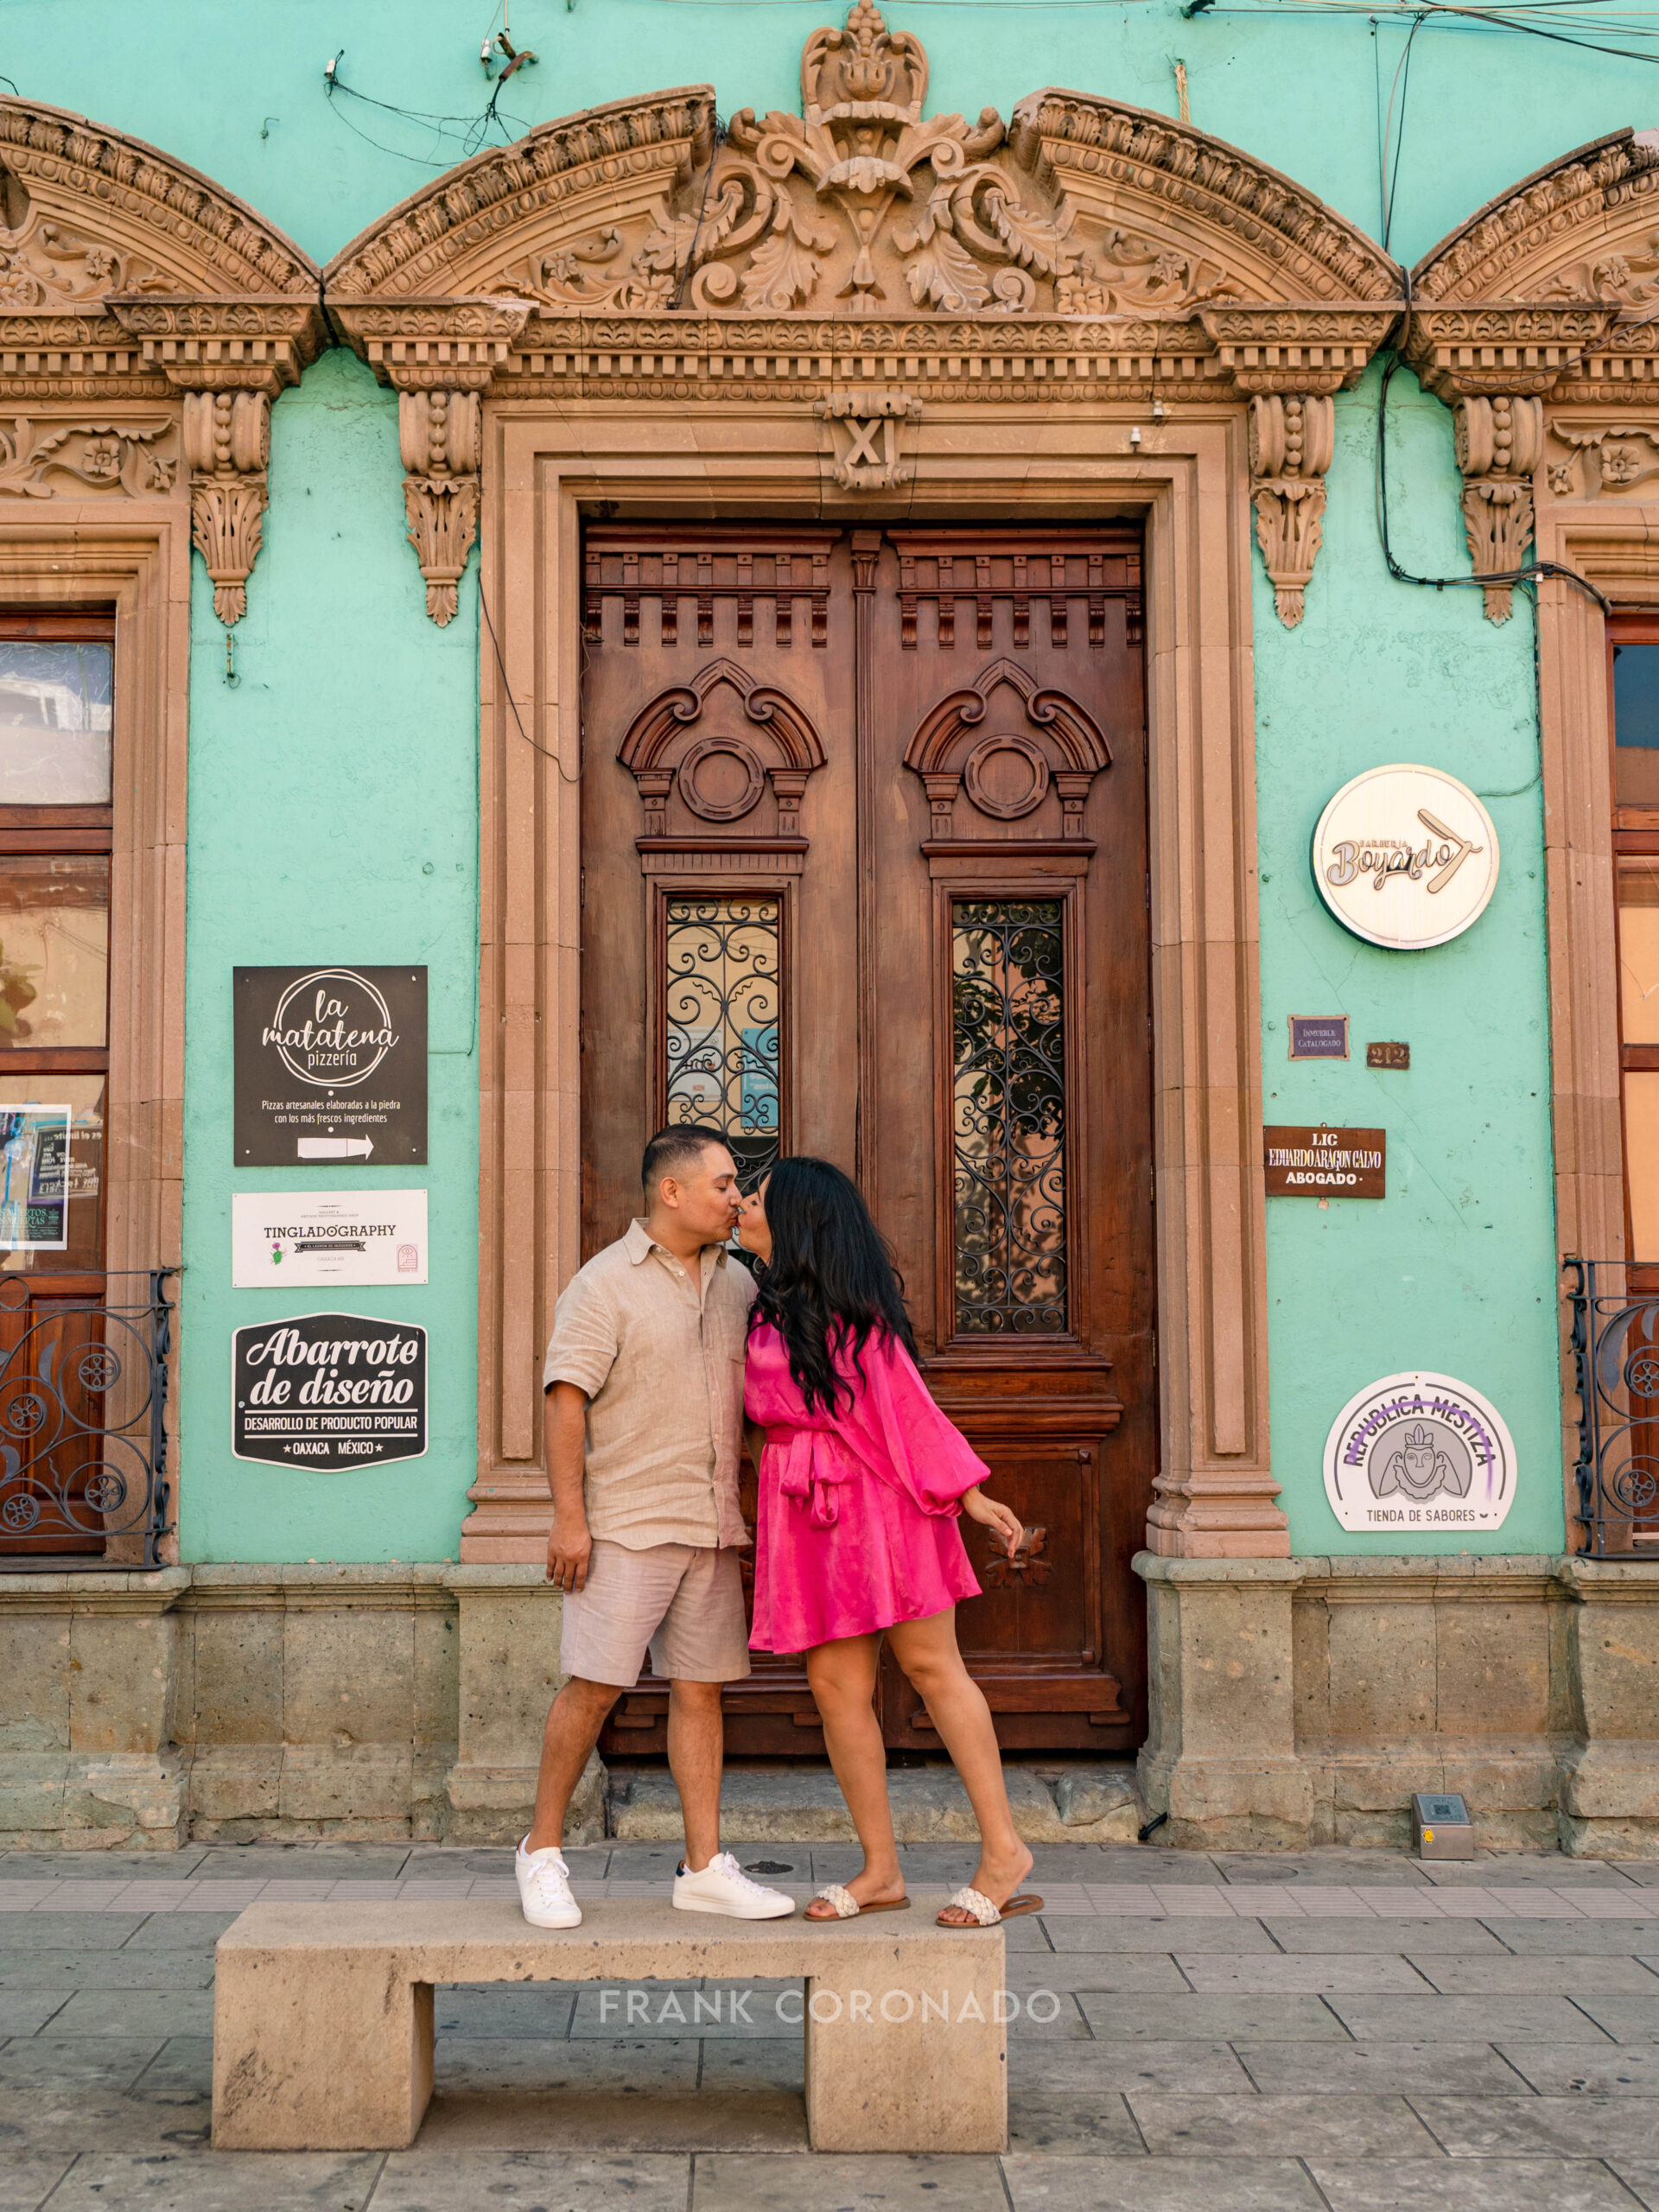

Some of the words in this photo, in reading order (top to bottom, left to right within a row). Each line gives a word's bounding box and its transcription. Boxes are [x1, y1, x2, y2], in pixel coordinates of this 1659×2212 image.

[1326, 839, 1453, 891] Boyardo
[315, 989, 349, 1023] la
[262, 1020, 400, 1051] matatena
[308, 1050, 358, 1070] pizzería
[1371, 1046, 1405, 1065] 212
[262, 1100, 284, 1110] Pizzas
[285, 1100, 325, 1110] artesanales
[326, 1100, 364, 1110] elaboradas
[371, 1100, 378, 1109] la
[378, 1100, 401, 1111] piedra
[274, 1115, 288, 1123] con
[289, 1113, 299, 1123] los
[301, 1113, 315, 1123] más
[317, 1113, 342, 1125] frescos
[343, 1113, 388, 1125] ingredientes
[1268, 1148, 1314, 1167] EDUARDO
[1285, 1172, 1357, 1185] ABOGADO
[246, 1327, 418, 1366] Abarrote
[250, 1368, 292, 1405] de
[299, 1367, 415, 1405] diseño
[245, 1416, 303, 1431] DESARROLLO
[305, 1416, 319, 1430] DE
[321, 1416, 372, 1430] PRODUCTO
[374, 1415, 417, 1430] POPULAR
[1430, 1396, 1497, 1467] MESTIZA
[293, 1441, 329, 1455] OAXACA
[338, 1439, 374, 1455] MÉXICO
[1367, 1510, 1405, 1522] TIENDA
[1408, 1510, 1421, 1522] DE
[1426, 1510, 1476, 1522] SABORES
